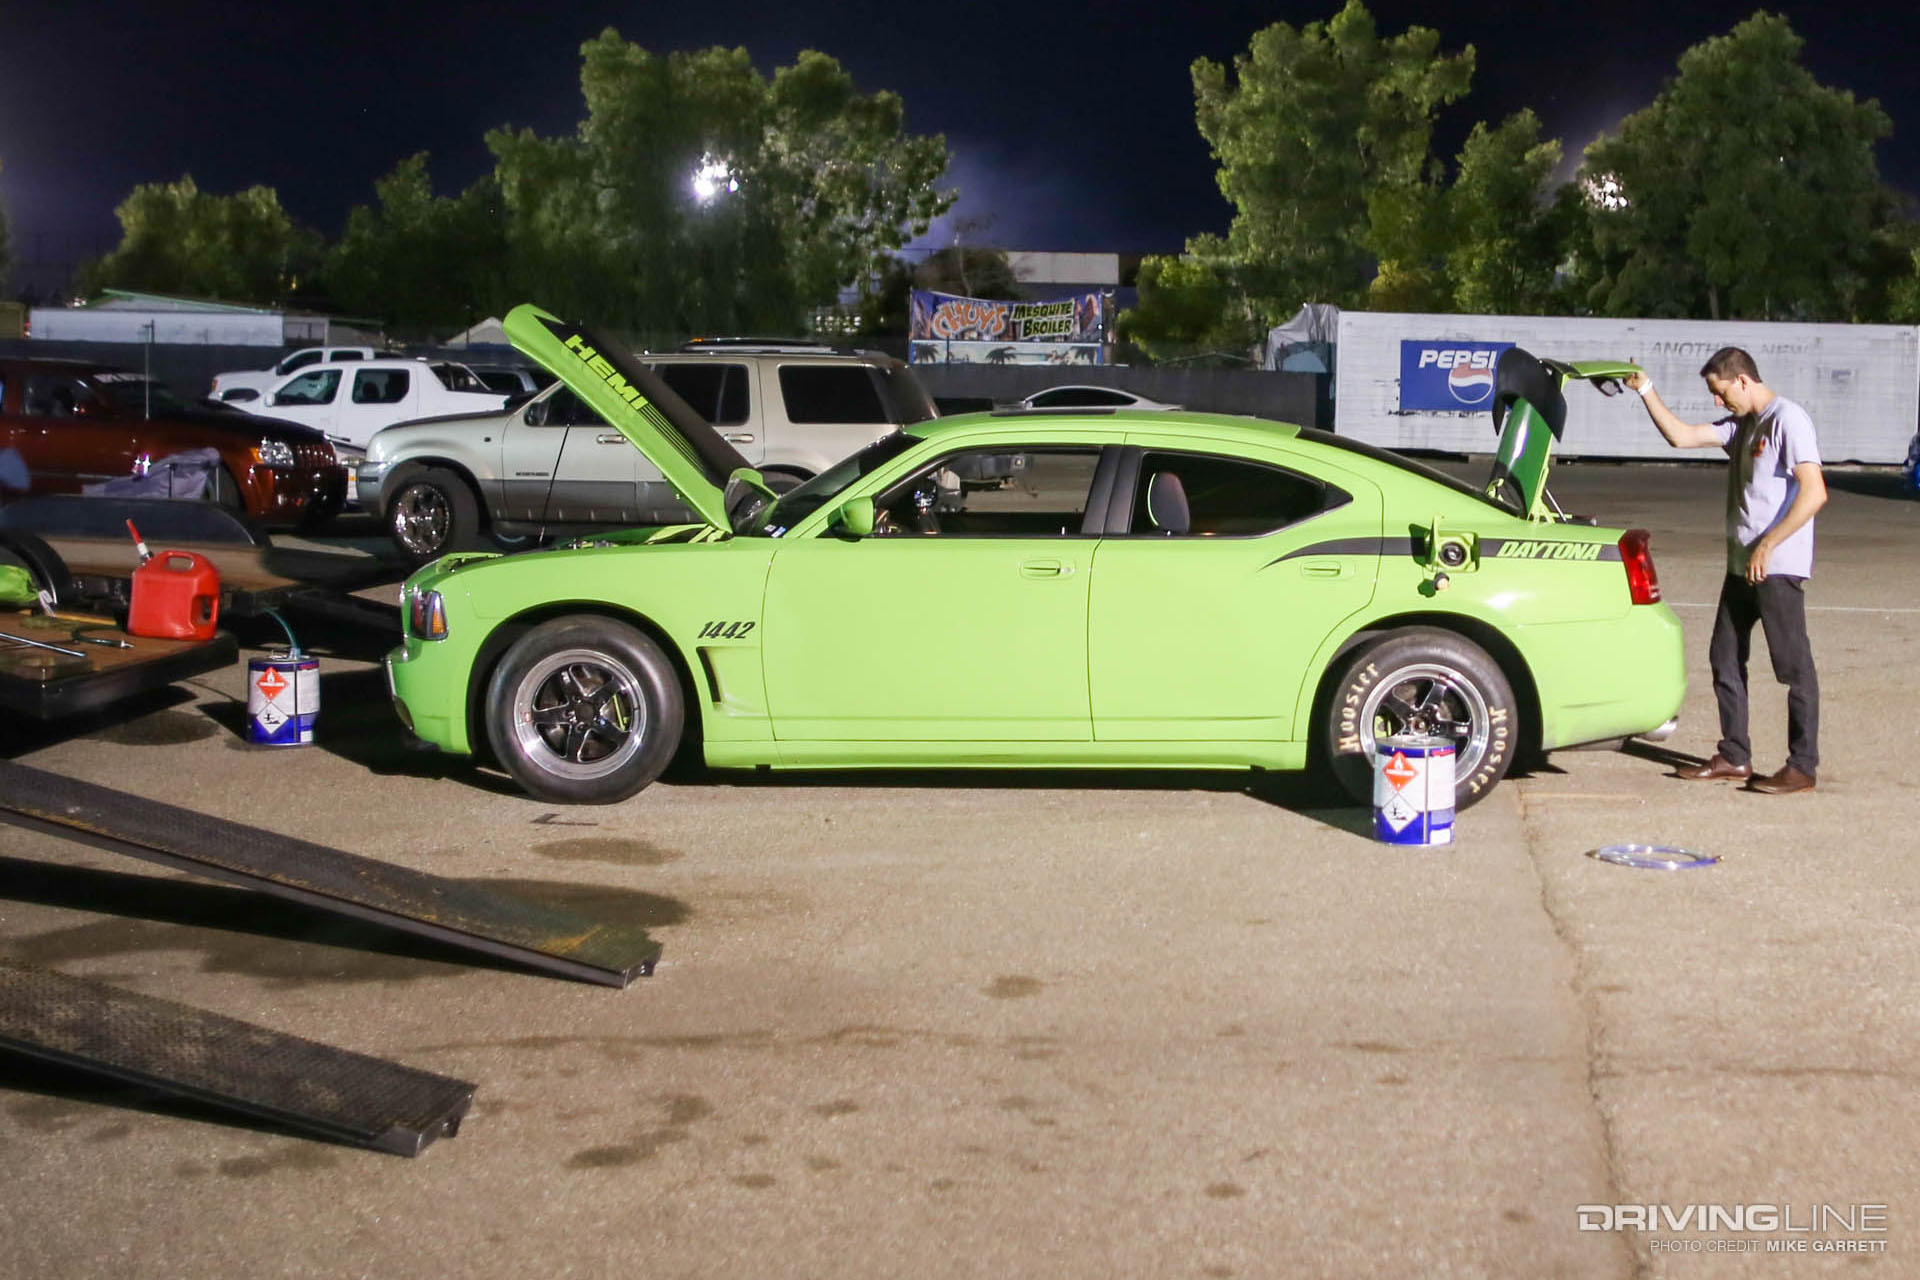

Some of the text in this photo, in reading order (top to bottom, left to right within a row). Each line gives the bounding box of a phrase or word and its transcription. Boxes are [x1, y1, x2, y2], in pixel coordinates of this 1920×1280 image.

[1012, 301, 1074, 320] MESQUITE
[1022, 319, 1073, 338] BROILER
[1418, 350, 1497, 369] PEPSI
[564, 334, 649, 411] HEMI
[1496, 541, 1602, 560] DAYTONA
[698, 621, 756, 639] 1442
